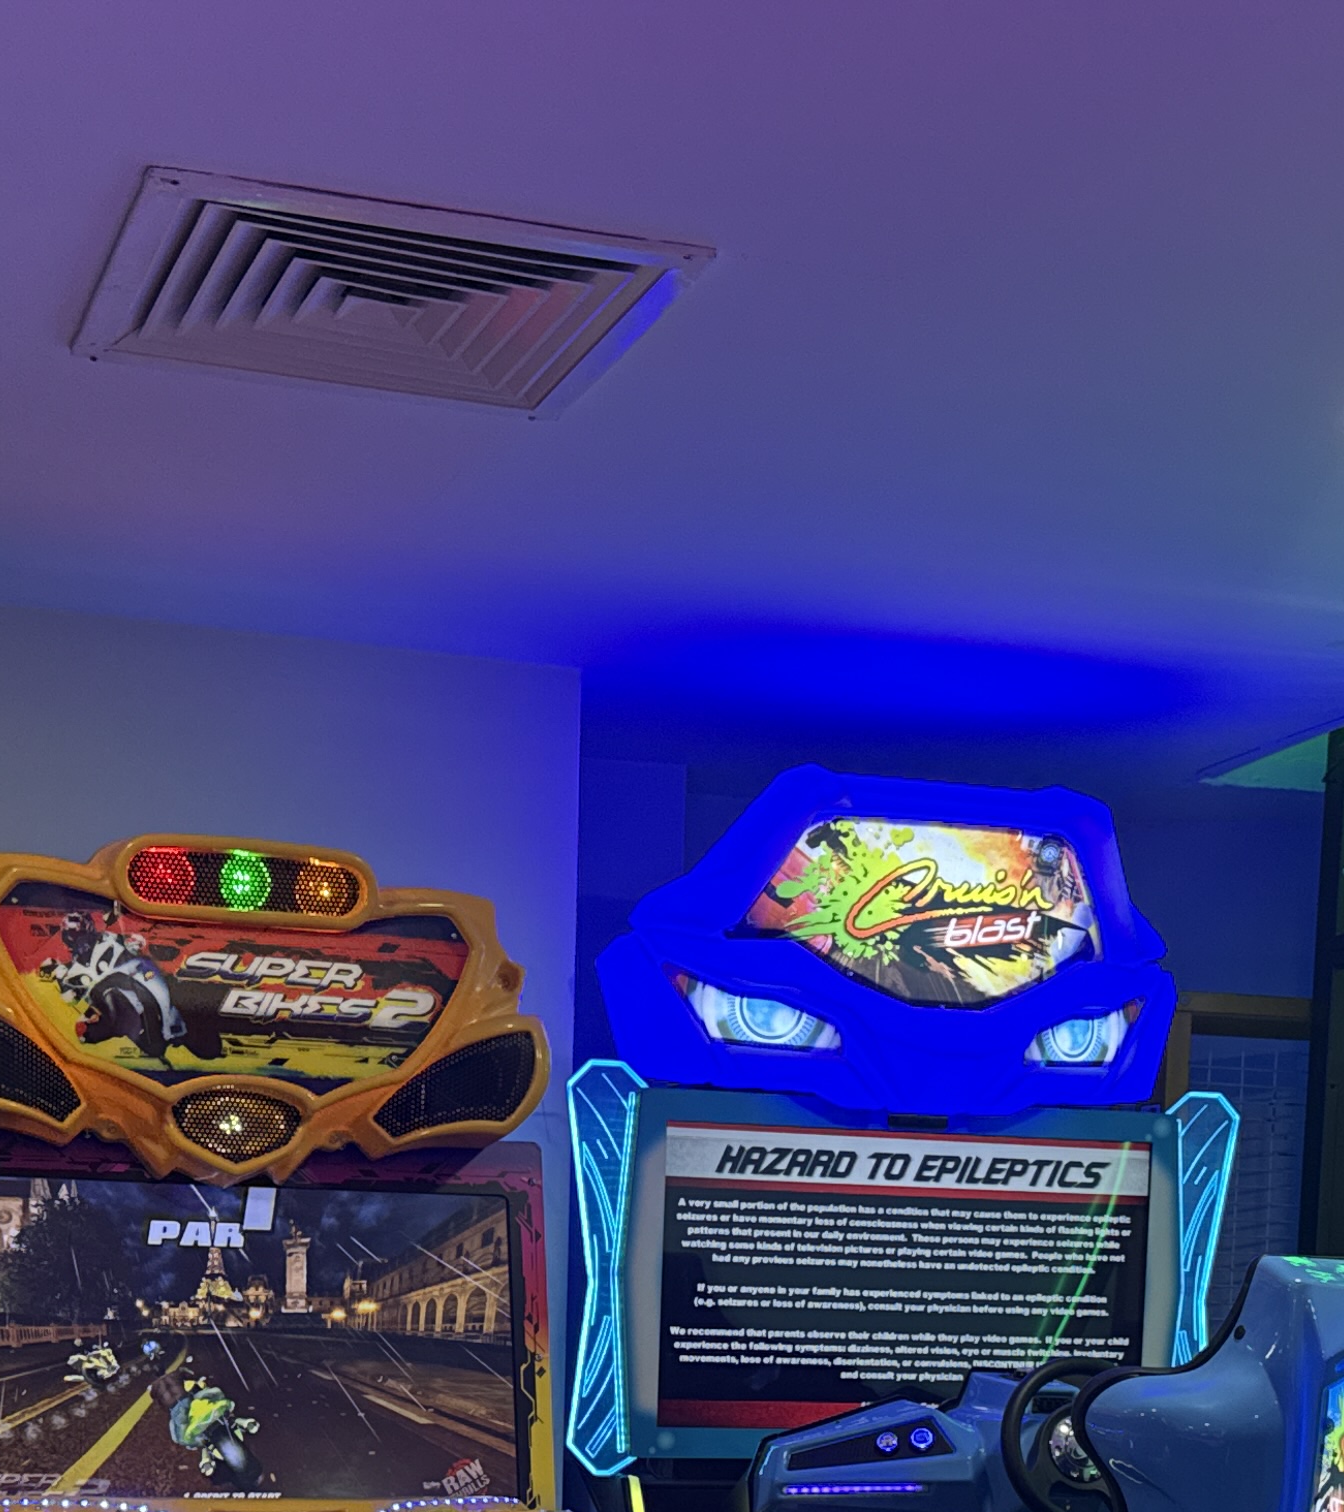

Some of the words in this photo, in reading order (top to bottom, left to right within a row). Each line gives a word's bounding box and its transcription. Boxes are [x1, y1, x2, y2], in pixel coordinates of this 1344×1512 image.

[944, 911, 1042, 949] blast
[177, 950, 364, 990] SUPER
[218, 989, 372, 1021] BIKES
[369, 989, 435, 1028] 2
[715, 1144, 859, 1181] HAZARD
[867, 1152, 912, 1183] TO
[914, 1153, 1112, 1190] EPILEPTICS
[678, 1197, 686, 1207] A
[688, 1198, 711, 1210] very
[713, 1198, 739, 1209] small
[776, 1201, 787, 1211] of
[789, 1201, 806, 1212] the
[858, 1204, 876, 1214] has
[877, 1206, 884, 1215] a
[930, 1207, 950, 1217] that
[951, 1209, 971, 1220] may
[973, 1210, 1001, 1219] cause
[1003, 1210, 1026, 1220] them
[1028, 1211, 1038, 1221] to
[719, 1213, 730, 1222] or
[732, 1213, 757, 1223] have
[814, 1216, 834, 1226] loss
[836, 1217, 847, 1226] of
[920, 1220, 946, 1230] when
[1019, 1224, 1044, 1233] kinds
[1045, 1225, 1056, 1234] of
[1121, 1229, 1130, 1237] or
[731, 1226, 752, 1236] that
[792, 1228, 802, 1238] in
[803, 1230, 820, 1239] our
[821, 1229, 844, 1241] daily
[912, 1233, 941, 1243] These
[980, 1236, 1001, 1247] may
[712, 1252, 731, 1262] had
[732, 1254, 750, 1265] any
[837, 1257, 858, 1268] may
[918, 1259, 942, 1269] have
[943, 1261, 956, 1270] an
[728, 1241, 754, 1250] some
[756, 1240, 782, 1251] kinds
[784, 1241, 795, 1252] of
[885, 1246, 896, 1255] or
[968, 1248, 993, 1258] video
[1064, 1251, 1084, 1261] who
[1085, 1252, 1108, 1262] have
[1109, 1253, 1125, 1263] not
[696, 1282, 705, 1292] If
[707, 1283, 726, 1294] you
[727, 1284, 738, 1293] or
[776, 1284, 786, 1295] in
[788, 1286, 810, 1297] your
[842, 1286, 860, 1297] has
[999, 1291, 1010, 1301] to
[1012, 1292, 1024, 1301] an
[760, 1299, 770, 1308] or
[772, 1298, 793, 1308] loss
[794, 1299, 805, 1308] of
[441, 1458, 484, 1495] RAW
